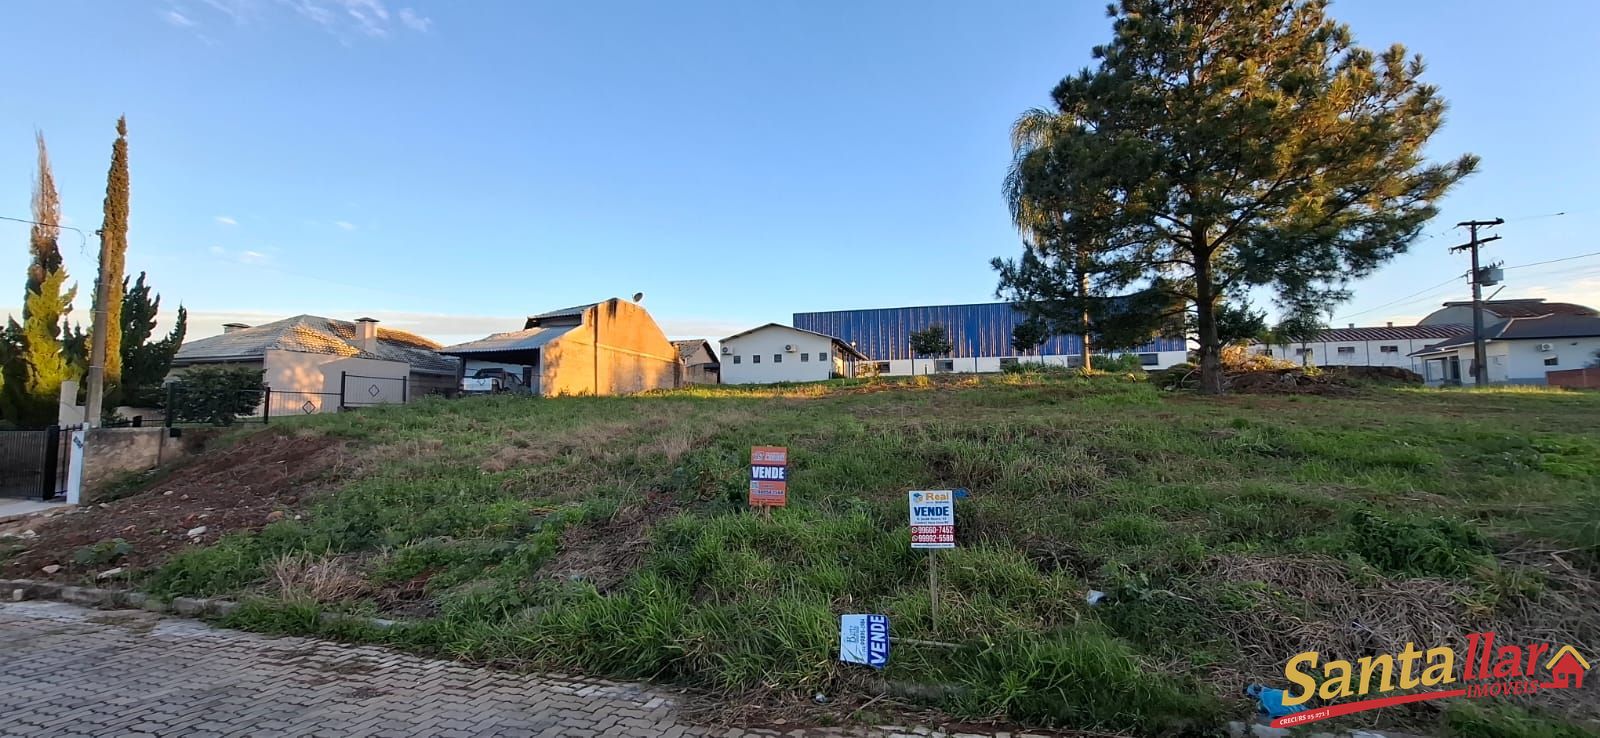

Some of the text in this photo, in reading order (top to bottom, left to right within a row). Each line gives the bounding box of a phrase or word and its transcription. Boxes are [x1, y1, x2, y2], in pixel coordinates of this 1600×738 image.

[752, 466, 785, 479] VENDE
[926, 492, 949, 501] Real
[914, 506, 950, 517] VENDE
[870, 615, 887, 664] VENDE
